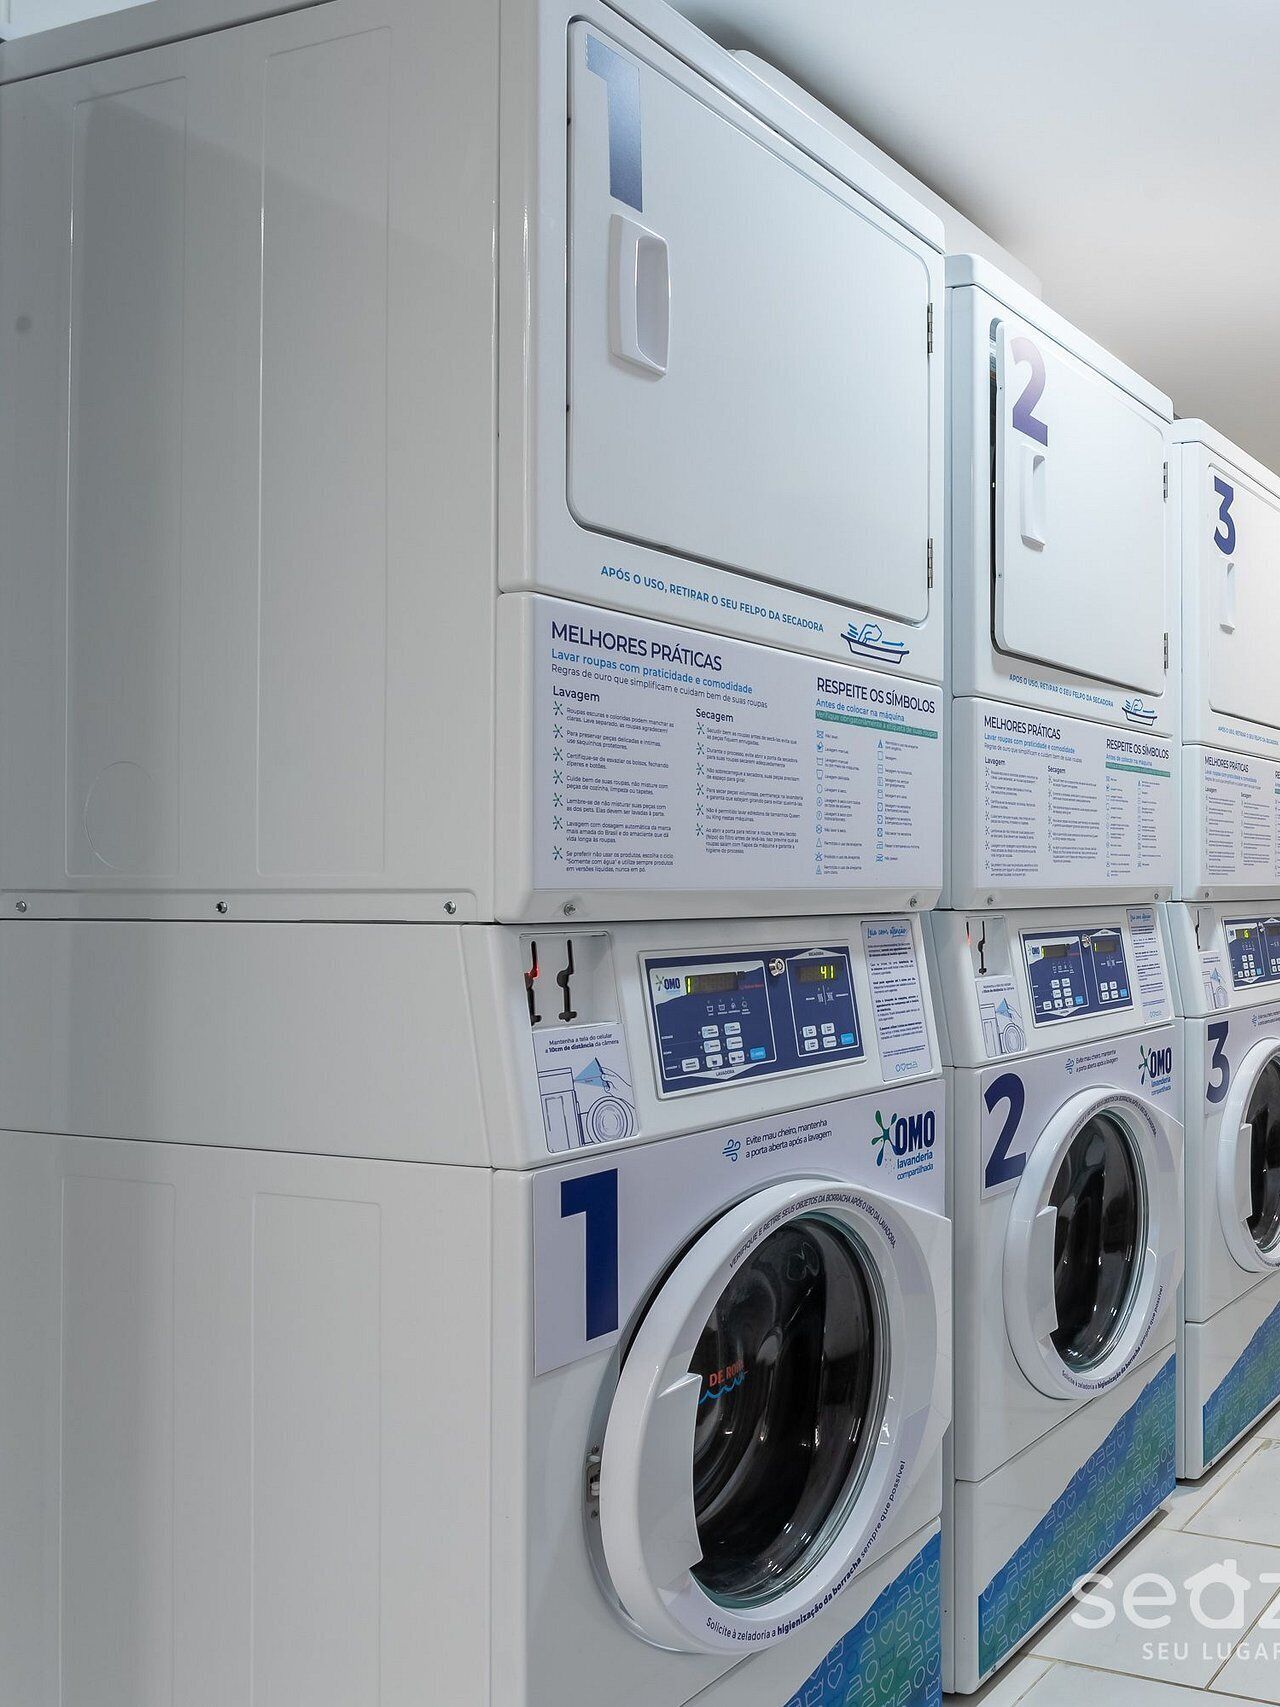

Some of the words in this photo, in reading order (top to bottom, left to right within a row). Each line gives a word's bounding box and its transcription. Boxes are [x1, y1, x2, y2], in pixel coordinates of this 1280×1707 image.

[587, 34, 642, 212] 1
[1010, 338, 1048, 446] 2
[1214, 478, 1235, 555] 3
[601, 565, 630, 582] APÓS
[633, 575, 641, 584] O
[644, 576, 667, 594] USO,
[670, 584, 709, 602] RETIRAR
[712, 595, 719, 605] O
[720, 598, 738, 610] SEU
[740, 602, 766, 617] FELPO
[768, 610, 780, 622] DA
[782, 614, 824, 632] SECADORA
[552, 621, 647, 656] MELHORES
[651, 643, 722, 671] PRÁTICAS
[551, 664, 580, 680] Regras
[582, 669, 592, 678] de
[594, 673, 612, 681] ouro
[614, 677, 628, 687] que
[630, 677, 672, 694] simplificam
[680, 685, 705, 698] cuidam
[707, 689, 721, 700] bem
[723, 692, 731, 701] de
[732, 696, 746, 705] suas
[748, 698, 767, 709] roupas
[552, 648, 579, 664] Lavar
[582, 656, 617, 672] roupas
[620, 662, 640, 674] com
[643, 664, 693, 685] praticidade
[703, 675, 752, 693] comodidade
[553, 685, 600, 702] Lavagem
[816, 699, 835, 709] Antes
[837, 702, 845, 712] de
[847, 706, 869, 716] colocar
[879, 710, 904, 721] máquina
[817, 677, 867, 700] RESPEITE
[870, 689, 884, 703] OS
[886, 690, 935, 713] SÍMBOLOS
[696, 708, 733, 722] Secagem
[984, 715, 1026, 734] MELHORES
[1028, 723, 1061, 740] PRÁTICAS
[985, 756, 1006, 766] Lavagem
[1107, 739, 1132, 753] RESPEITE
[1133, 745, 1141, 754] OS
[1142, 744, 1169, 760] SÍMBOLOS
[1048, 765, 1066, 774] Secagem
[664, 978, 680, 989] OMO
[1150, 1047, 1172, 1078] OMO
[1206, 1021, 1230, 1103] 3
[746, 1136, 761, 1145] Evite
[762, 1134, 776, 1142] mau
[778, 1128, 797, 1139] cheiro,
[798, 1119, 827, 1133] mantenha
[751, 1145, 767, 1160] porta
[769, 1141, 788, 1153] aberta
[789, 1137, 802, 1150] após
[808, 1130, 832, 1144] lavagem
[895, 1111, 935, 1155] OMO
[984, 1073, 1026, 1189] 2
[897, 1150, 933, 1169] lavanderia
[897, 1163, 933, 1180] compartilhada
[729, 1231, 757, 1268] VERIFIQUE
[758, 1227, 763, 1235] E
[763, 1214, 781, 1232] RETIRE
[782, 1206, 795, 1218] SEUS
[795, 1195, 817, 1211] OBJETOS
[826, 1194, 850, 1202] BORRACHA
[850, 1195, 862, 1210] APÓS
[865, 1204, 875, 1216] USO
[873, 1210, 881, 1221] DA
[560, 1168, 619, 1341] 1
[707, 1617, 731, 1637] Solicite
[732, 1628, 736, 1638] à
[737, 1629, 770, 1641] zeladoria
[777, 1601, 823, 1635] higienização
[823, 1594, 832, 1605] da
[833, 1557, 861, 1596] borracha
[861, 1522, 881, 1558] sempre
[881, 1503, 890, 1522] que
[889, 1461, 905, 1501] possível
